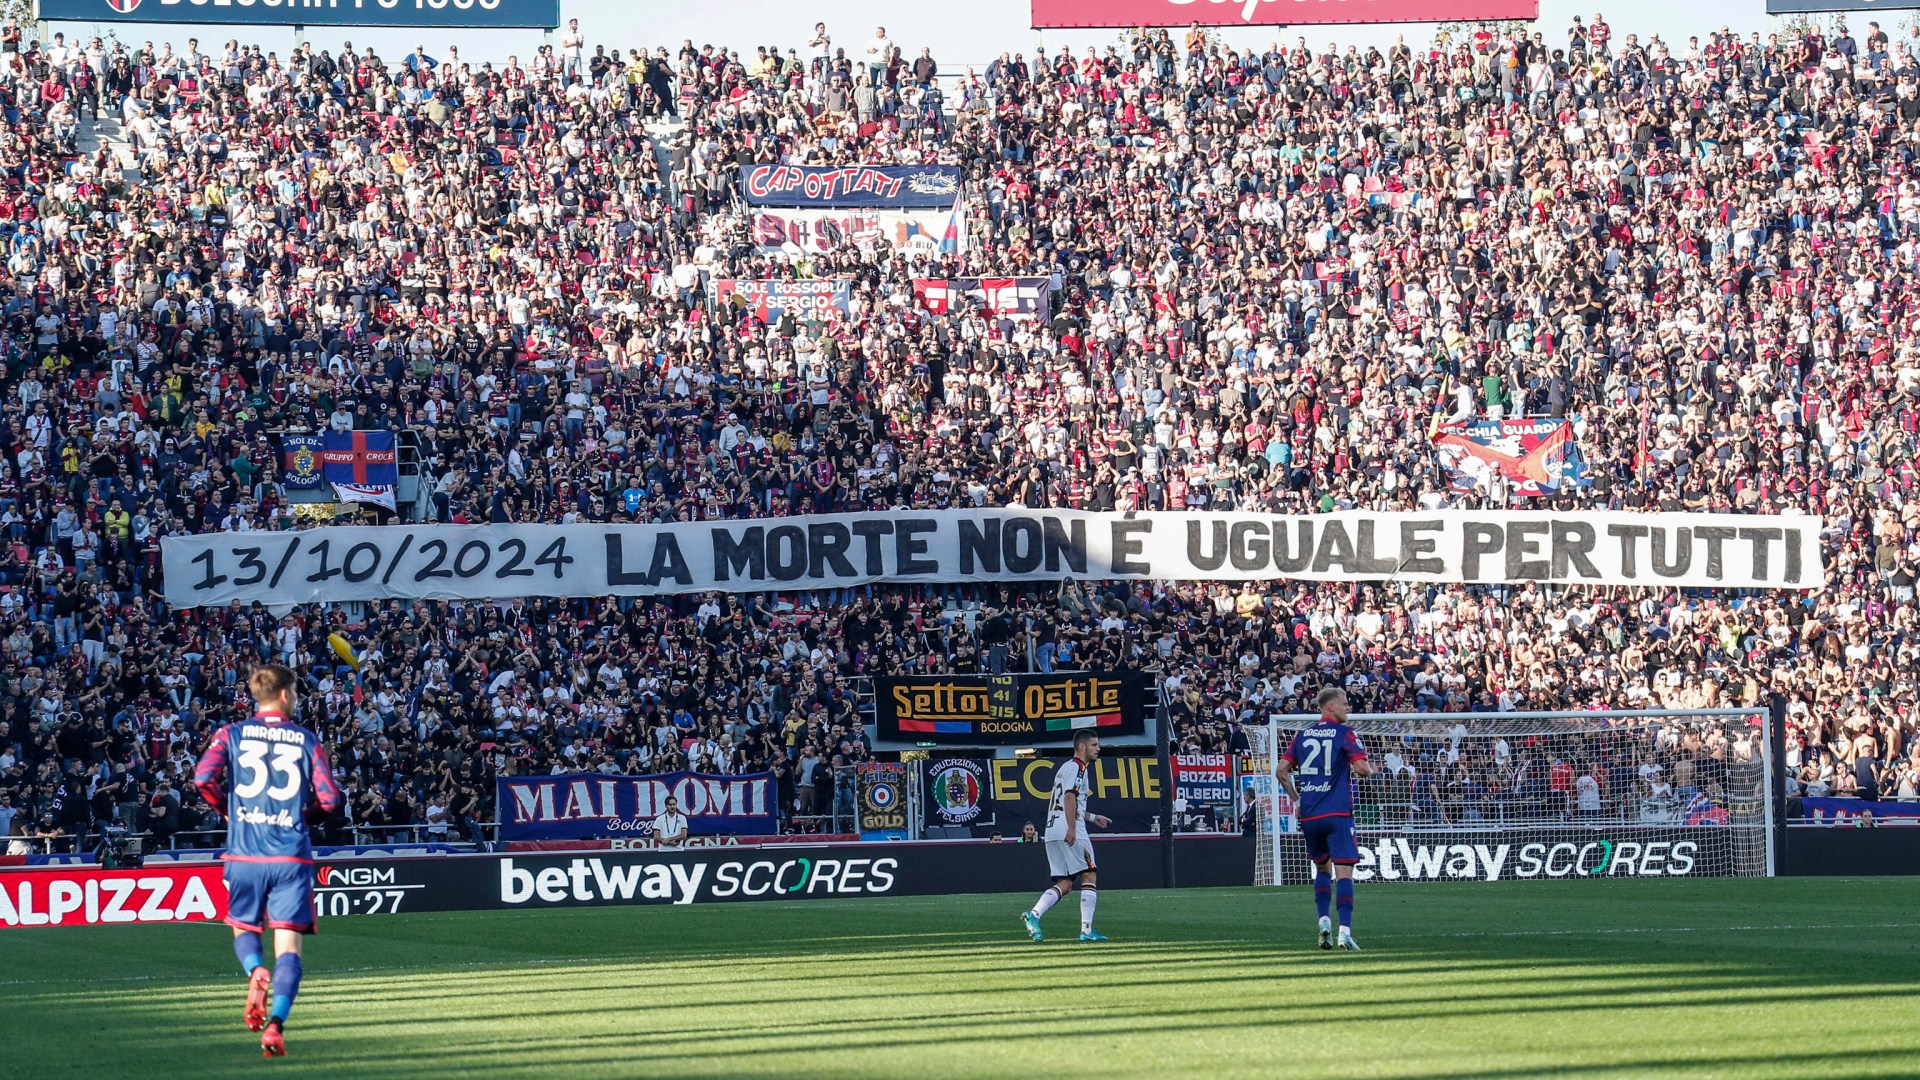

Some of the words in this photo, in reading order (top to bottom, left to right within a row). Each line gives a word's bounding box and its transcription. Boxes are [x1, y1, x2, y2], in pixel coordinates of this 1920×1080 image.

[750, 166, 903, 199] CAPOTTATI
[735, 282, 768, 294] SOLE
[774, 282, 846, 293] ROSSOBLU
[766, 296, 829, 308] SERGIO
[289, 437, 305, 445] NOI
[307, 438, 317, 446] DI
[324, 453, 353, 461] GRUPPO
[285, 472, 321, 485] BOLOGNA
[191, 534, 574, 590] 13/10/2024
[604, 532, 694, 586] LA
[711, 518, 939, 582] MORTE
[957, 515, 1088, 574] NON
[1110, 511, 1153, 575] É
[1186, 519, 1446, 575] UGUALE
[1462, 519, 1602, 581] PER
[1607, 523, 1802, 584] TUTTI
[893, 682, 990, 718] Settor
[1024, 677, 1119, 719] Ostile
[993, 689, 1010, 701] 41
[981, 721, 1034, 732] BOLOGNA
[242, 725, 305, 745] MIRANDA
[1176, 754, 1226, 766] SONGA
[1300, 738, 1333, 776] 21
[234, 739, 302, 801] 33
[857, 762, 904, 774] PRIMA
[928, 758, 983, 777] EDUCAZIONE
[865, 772, 898, 783] FILA
[992, 757, 1162, 800] ECHIE
[1179, 770, 1226, 783] BOZZA
[510, 780, 620, 823] MAI
[632, 777, 770, 818] DOMI
[1176, 787, 1231, 800] ALBERO
[863, 815, 904, 829] GOLD
[936, 807, 982, 823] FELSINEA
[606, 818, 654, 835] Bolog
[610, 837, 740, 850] BOGNA
[1312, 837, 1511, 882] etway
[1515, 840, 1698, 877] SCORES
[327, 867, 395, 886] NGM
[500, 858, 708, 905] betway
[712, 858, 899, 897] SCORES
[313, 890, 405, 917] 10:27
